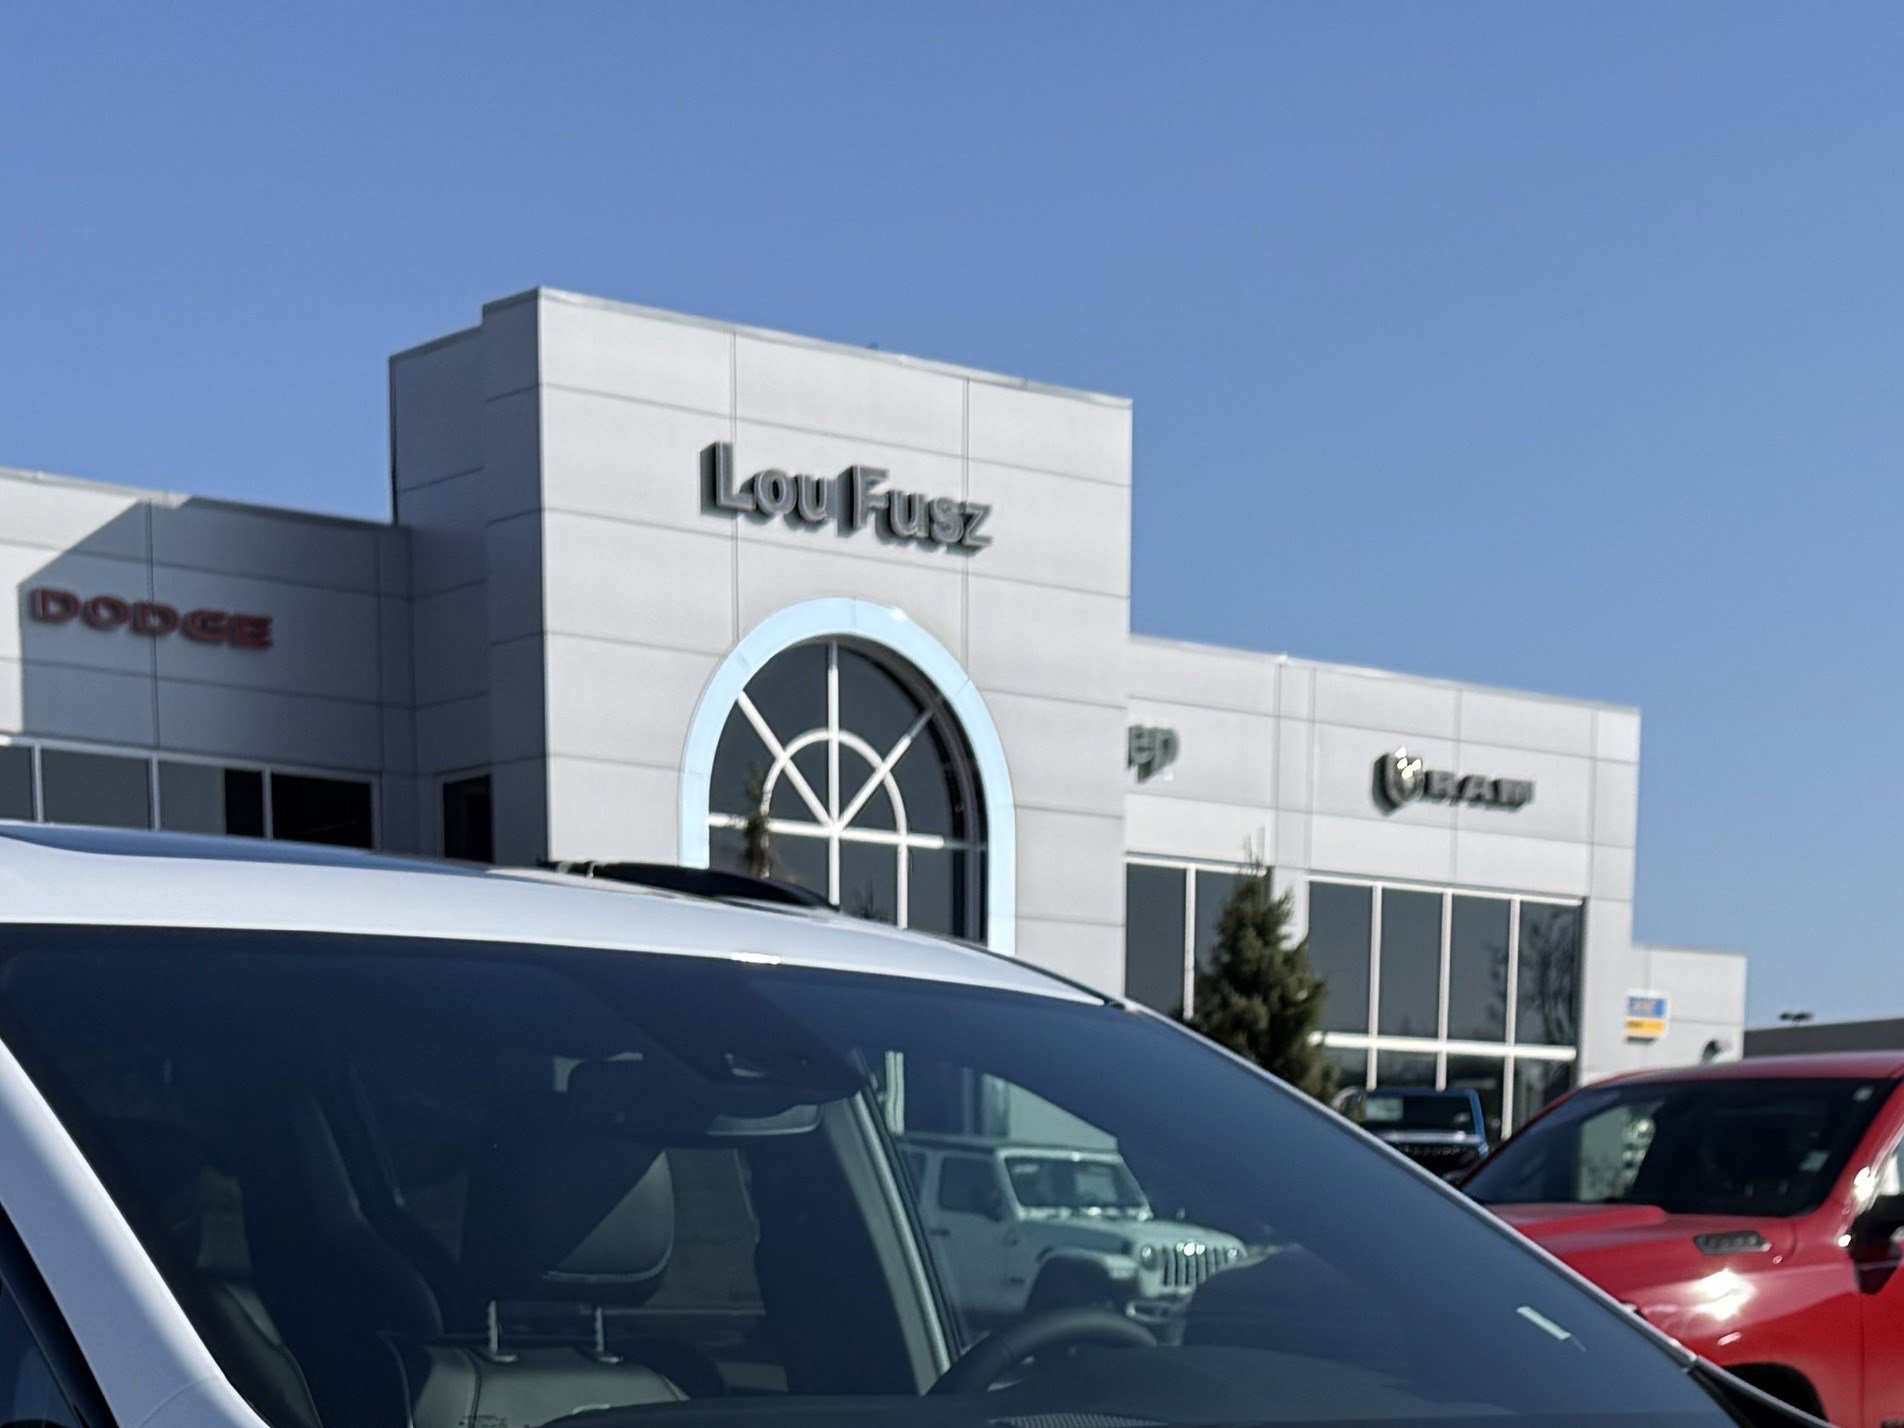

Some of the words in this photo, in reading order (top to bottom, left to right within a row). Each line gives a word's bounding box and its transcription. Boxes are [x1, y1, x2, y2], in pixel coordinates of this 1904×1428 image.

[700, 440, 834, 532] Lou
[838, 463, 995, 556] Fusz
[29, 586, 273, 649] DODGE
